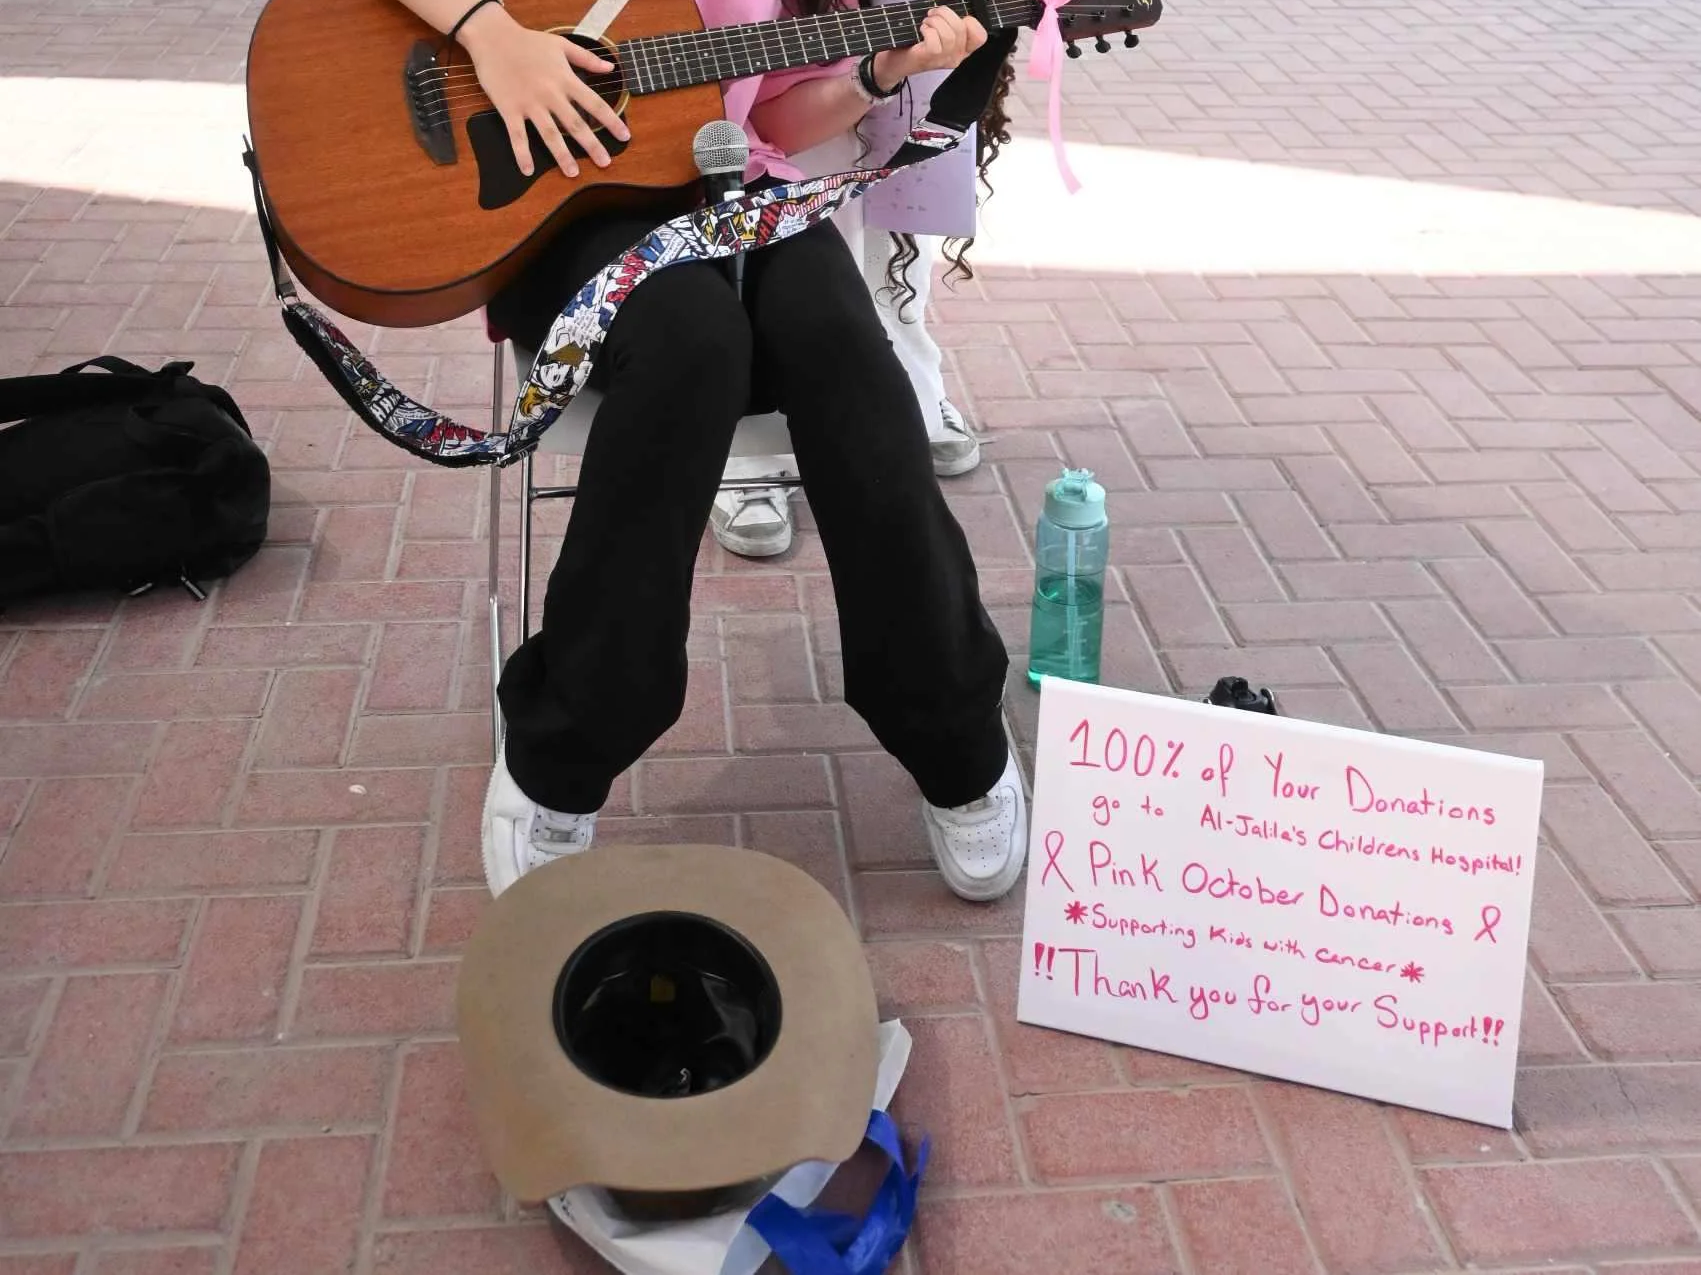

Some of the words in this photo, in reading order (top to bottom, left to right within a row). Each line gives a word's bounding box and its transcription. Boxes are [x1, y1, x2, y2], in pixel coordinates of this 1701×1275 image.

[1070, 718, 1185, 779] 100%
[1200, 744, 1235, 797] of
[1263, 751, 1321, 801] Your
[1344, 764, 1497, 827] Donations
[1091, 795, 1121, 826] go
[1140, 796, 1165, 817] to
[1317, 830, 1421, 862] Childrens
[1430, 846, 1523, 876] Hospital!
[1181, 861, 1305, 907] October
[1318, 883, 1455, 937] Donations
[1262, 938, 1306, 960] with
[1188, 985, 1238, 1022] you
[1248, 974, 1293, 1017] for
[1300, 994, 1364, 1028] your
[1372, 993, 1506, 1048] Support!!
